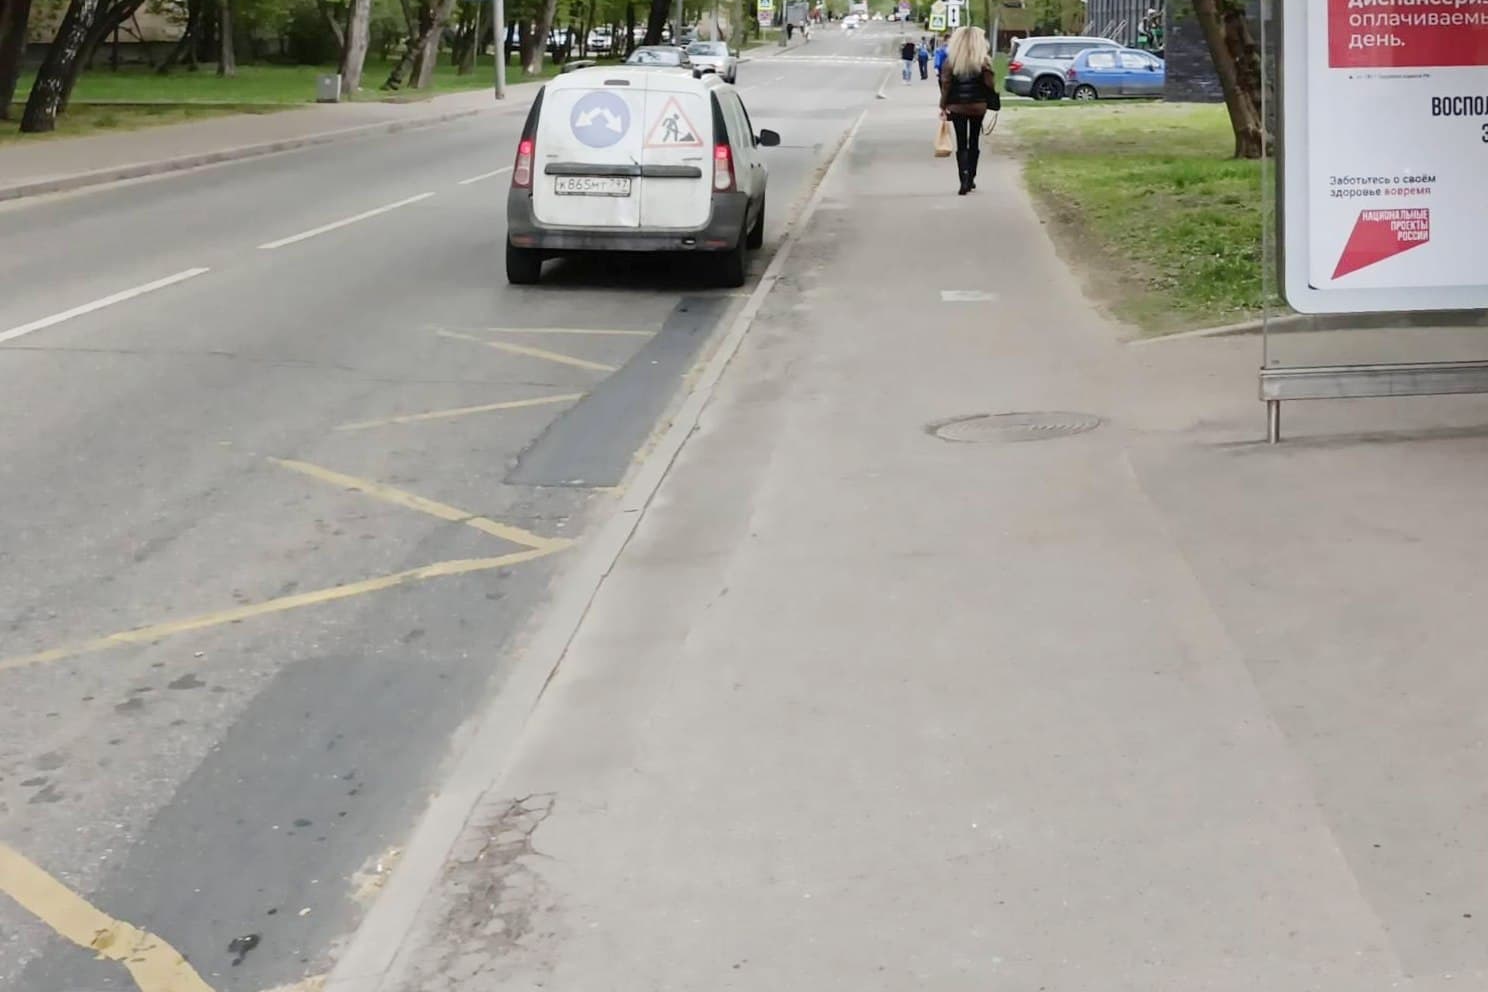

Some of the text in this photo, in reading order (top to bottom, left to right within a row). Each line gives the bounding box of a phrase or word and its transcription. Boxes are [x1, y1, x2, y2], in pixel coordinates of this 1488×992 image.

[1349, 33, 1406, 49] день.
[1329, 176, 1391, 185] Заботьтесь
[1393, 176, 1400, 184] о
[1330, 187, 1431, 199] здоровье вовремя
[1390, 220, 1428, 231] ПРОЕКТЫ
